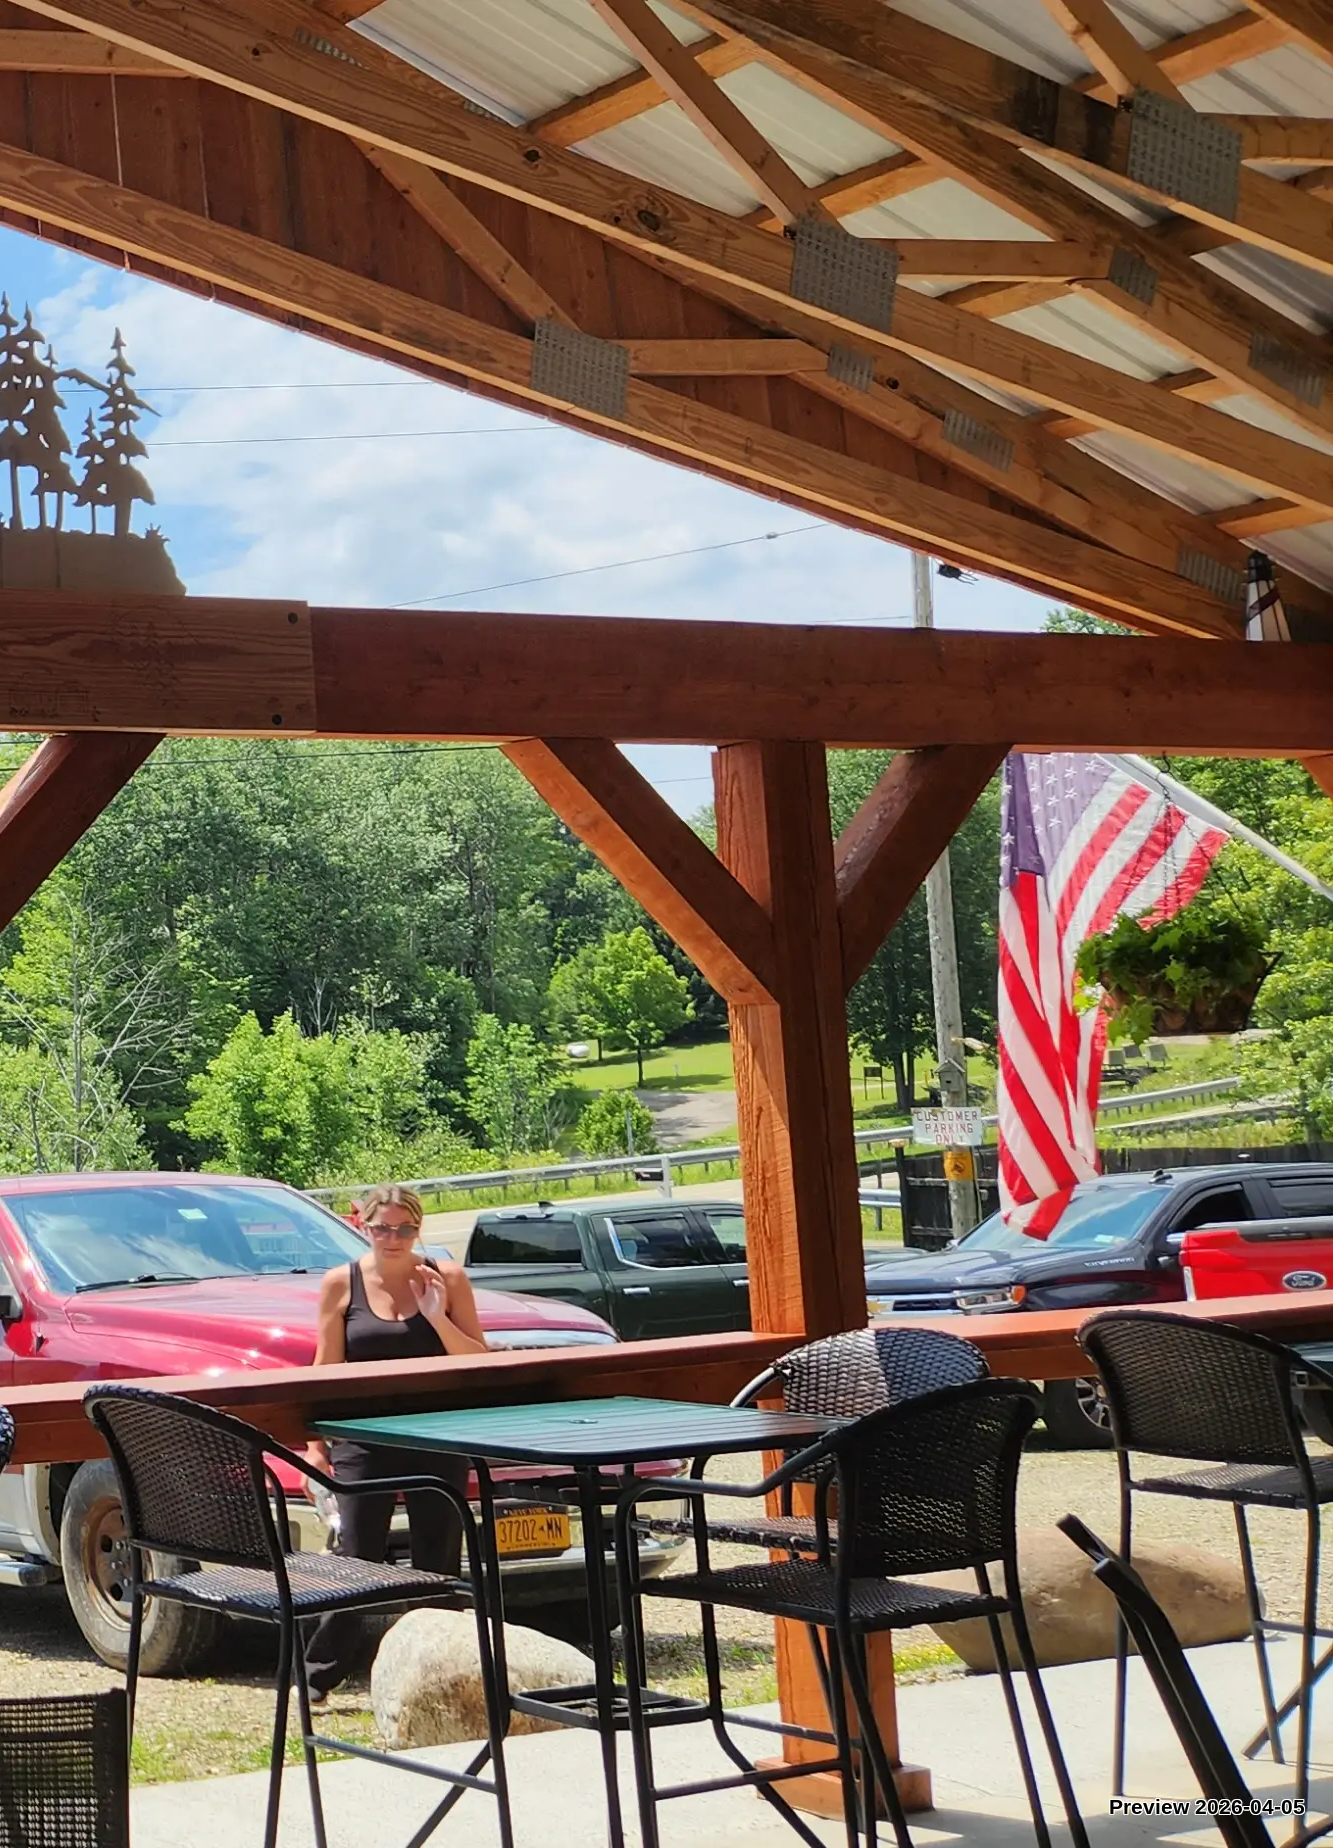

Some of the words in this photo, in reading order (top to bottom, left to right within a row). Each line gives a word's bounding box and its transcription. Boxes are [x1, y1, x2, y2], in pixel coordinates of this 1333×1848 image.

[916, 1110, 978, 1122] CUSTOMER
[924, 1123, 974, 1133] PARKING
[499, 1519, 538, 1543] 37202
